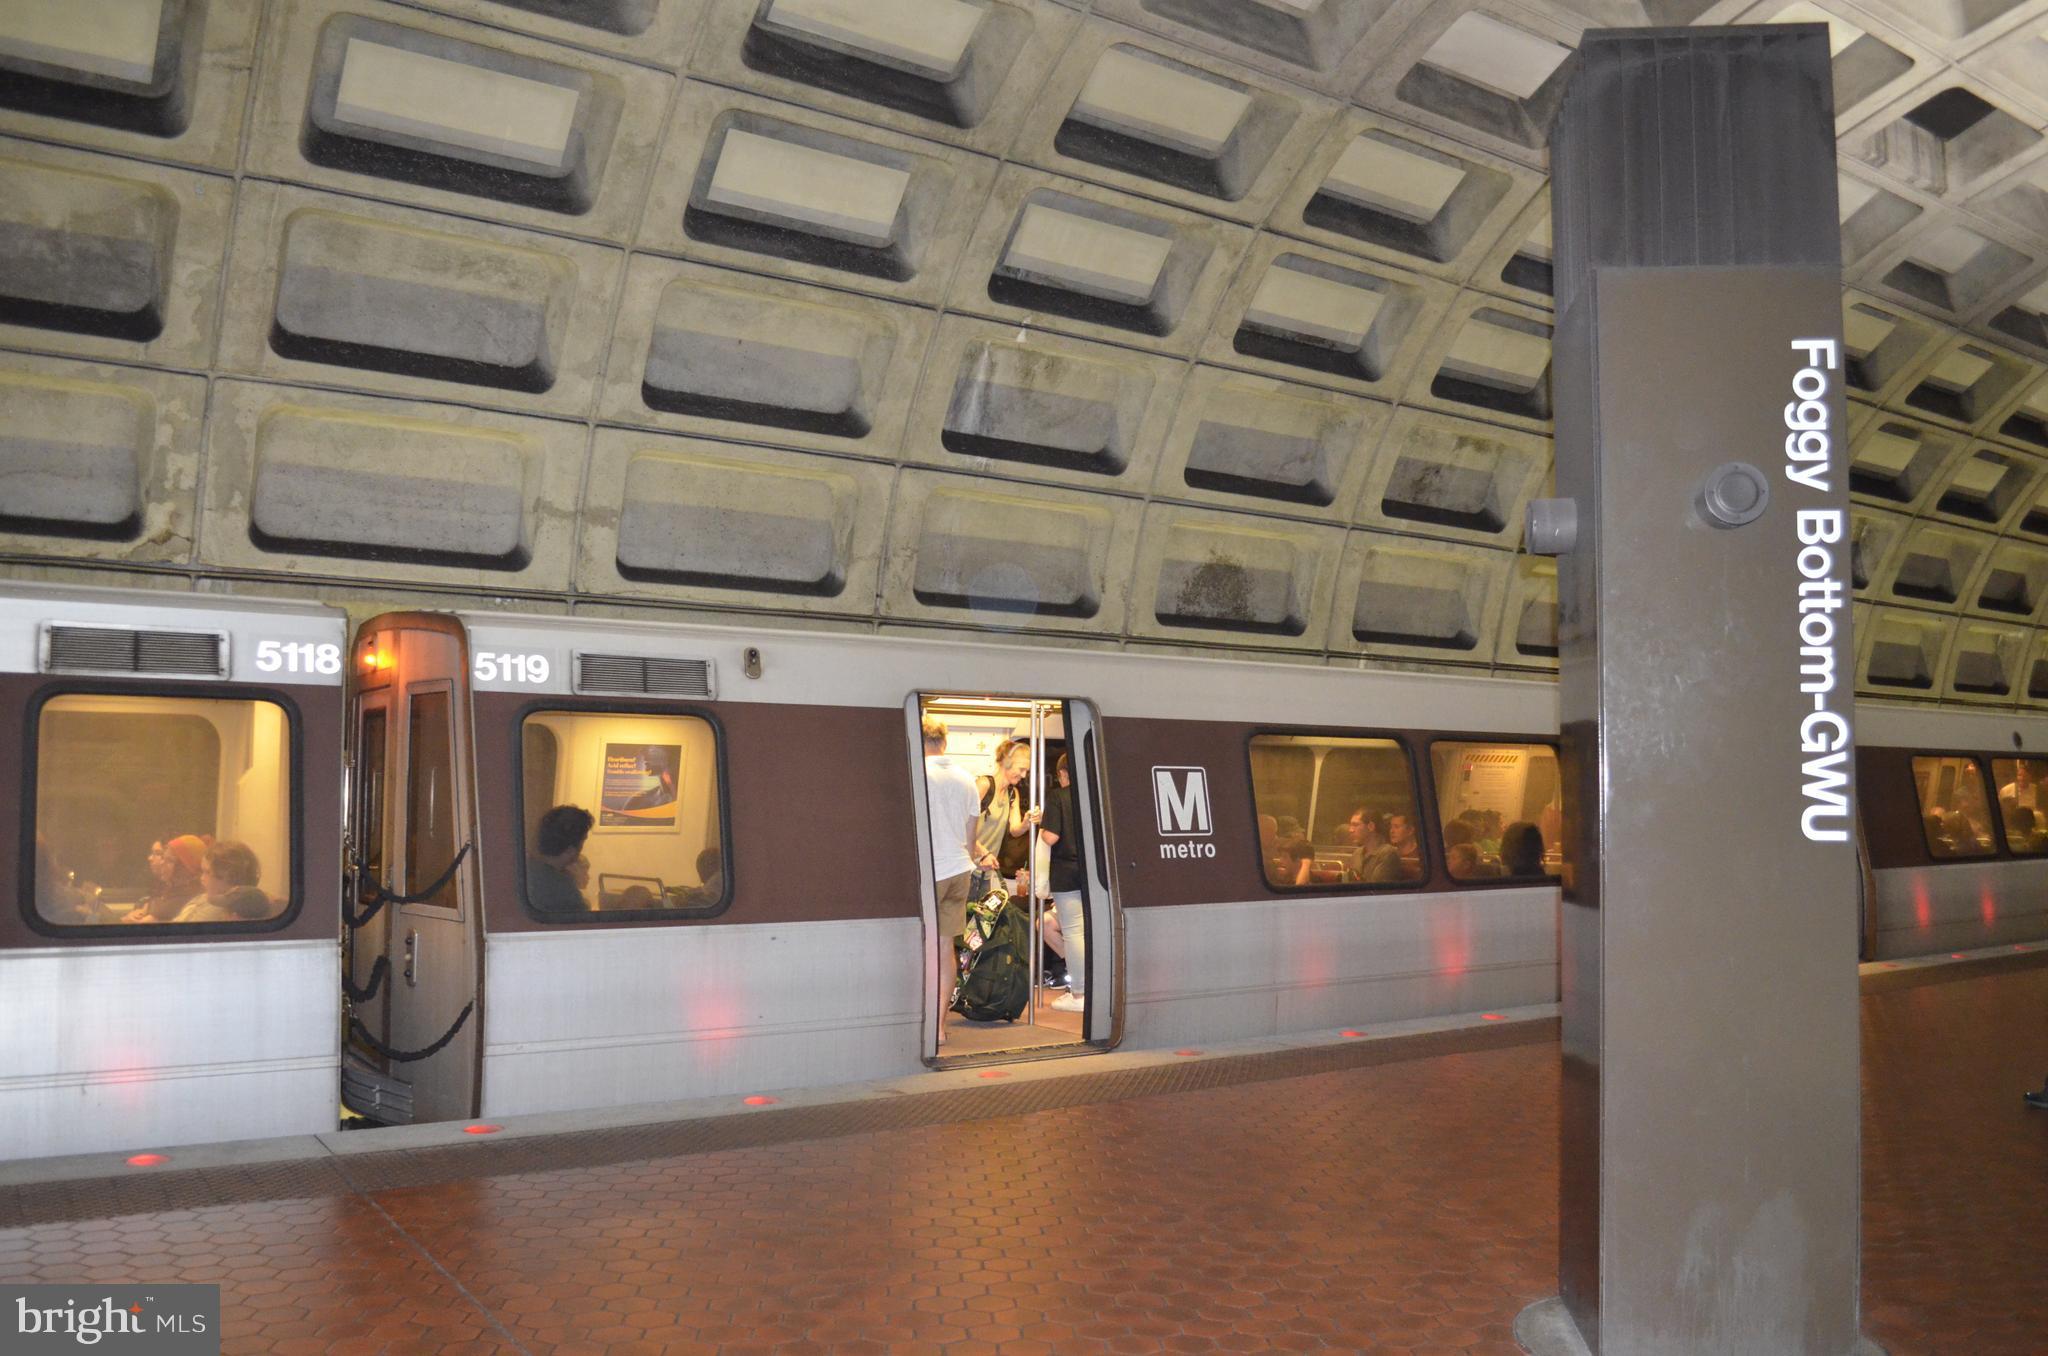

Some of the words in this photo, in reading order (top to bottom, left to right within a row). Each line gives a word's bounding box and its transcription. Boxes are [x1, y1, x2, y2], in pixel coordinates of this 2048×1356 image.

[1784, 339, 1836, 492] Foggy
[255, 640, 341, 675] 5118
[474, 652, 550, 684] 5119
[1796, 510, 1848, 842] Bottom-GWU
[1155, 771, 1209, 831] M
[1160, 840, 1216, 859] metro
